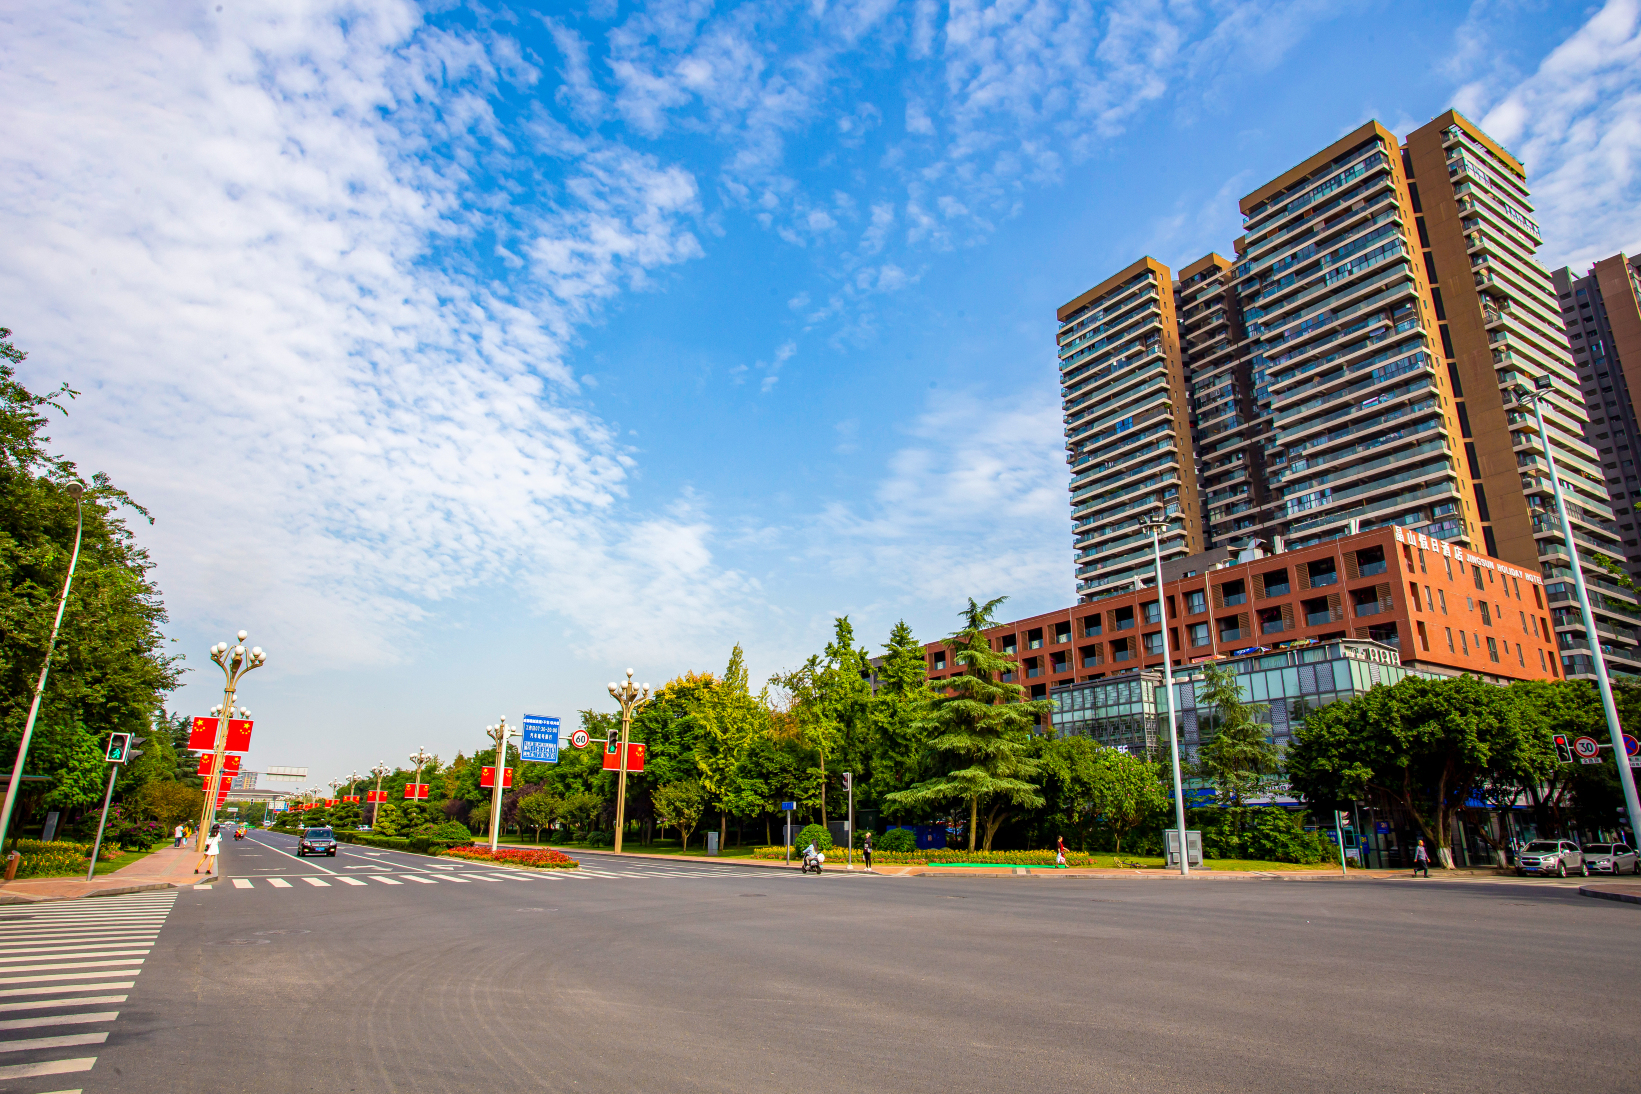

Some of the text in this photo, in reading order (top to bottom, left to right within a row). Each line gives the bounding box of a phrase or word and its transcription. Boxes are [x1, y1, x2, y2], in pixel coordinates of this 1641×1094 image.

[1466, 553, 1543, 585] JINGSUN HOLIDAY HOTEL
[1578, 743, 1593, 752] 30
